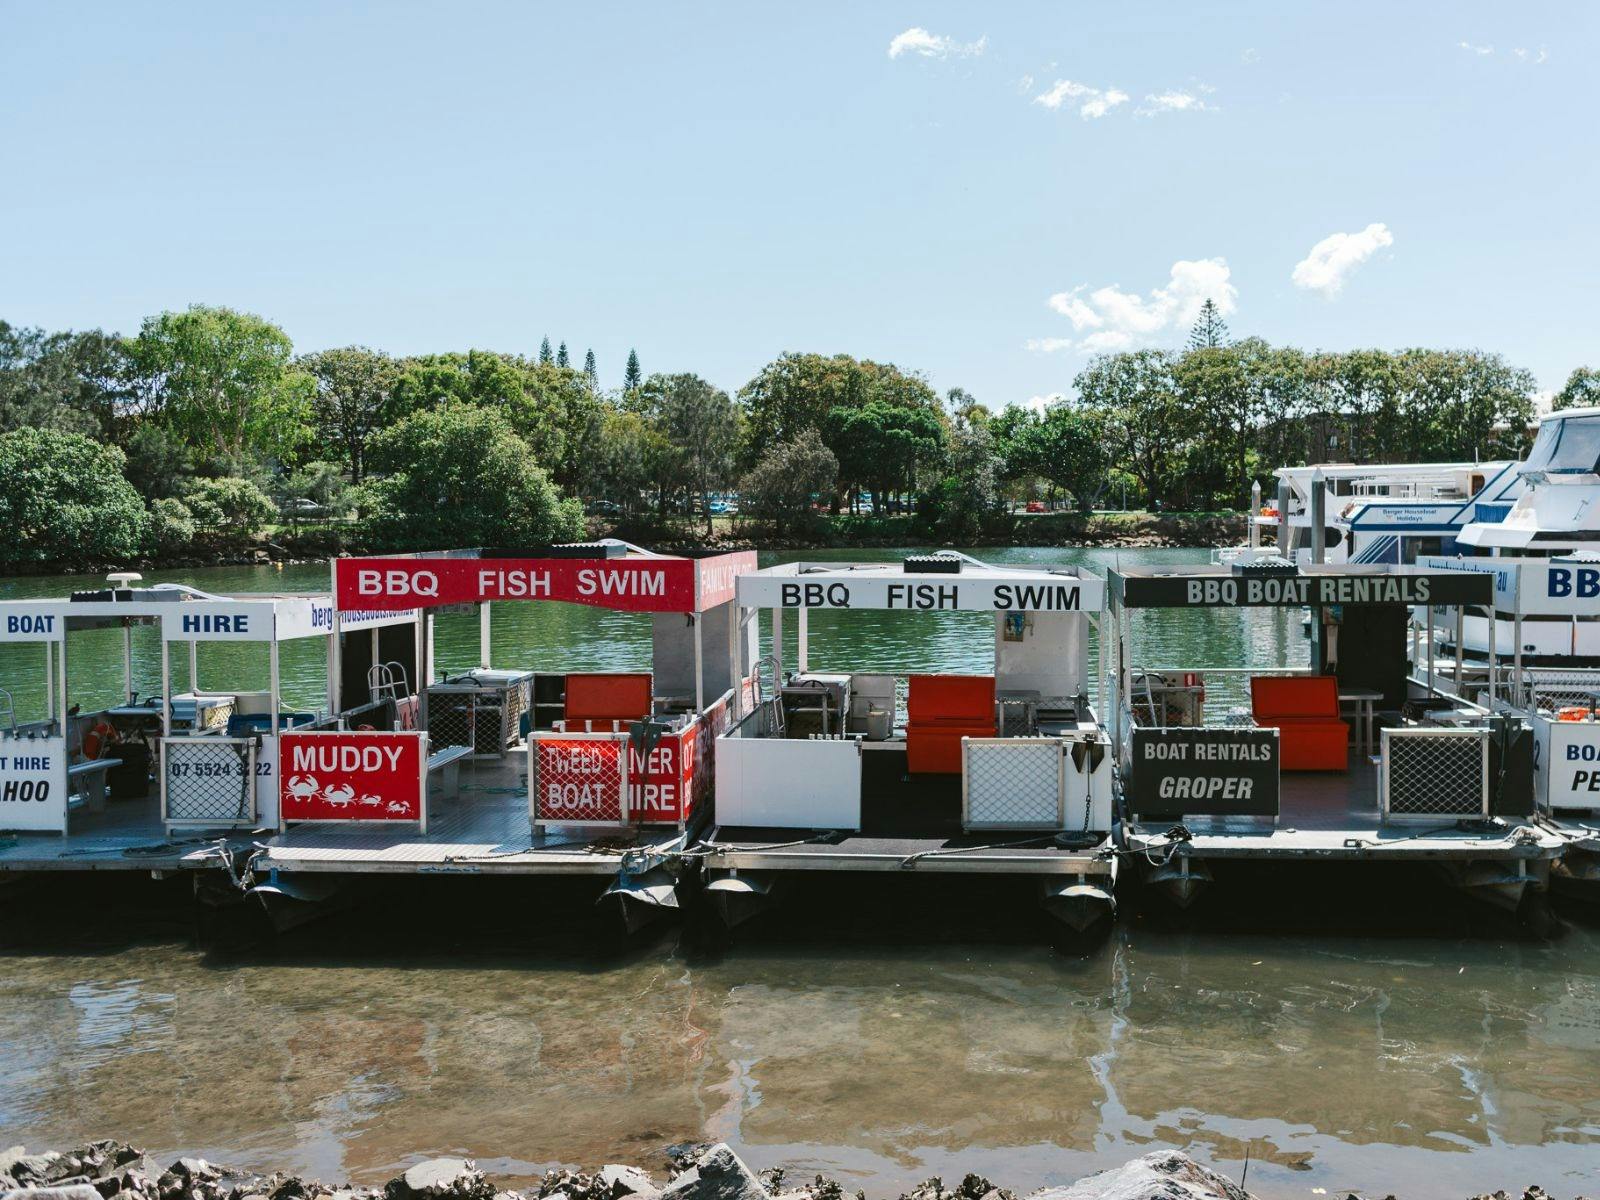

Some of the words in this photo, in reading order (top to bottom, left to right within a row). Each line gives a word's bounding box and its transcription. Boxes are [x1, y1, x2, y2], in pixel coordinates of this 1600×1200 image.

[358, 569, 439, 597] BBQ
[478, 570, 551, 596] FISH
[576, 569, 666, 596] SWIM
[1187, 579, 1238, 606] BBQ
[1247, 579, 1311, 603] BOAT
[1320, 577, 1430, 602] RENTALS
[781, 583, 850, 608] BBQ
[887, 584, 959, 609] FISH
[993, 584, 1081, 611] SWIM
[8, 615, 55, 633] BOAT
[182, 615, 249, 633] HIRE
[293, 745, 404, 773] MUDDY
[546, 747, 602, 774] TWEED
[1144, 742, 1189, 760] BOAT
[1195, 743, 1271, 761] RENTALS
[1566, 744, 1600, 761] BO
[14, 757, 50, 770] HIRE
[172, 763, 190, 777] 07
[194, 763, 231, 777] 5524
[236, 762, 272, 777] 322
[0, 780, 50, 802] HOO
[548, 783, 606, 809] BOAT
[1159, 776, 1254, 799] GROPER
